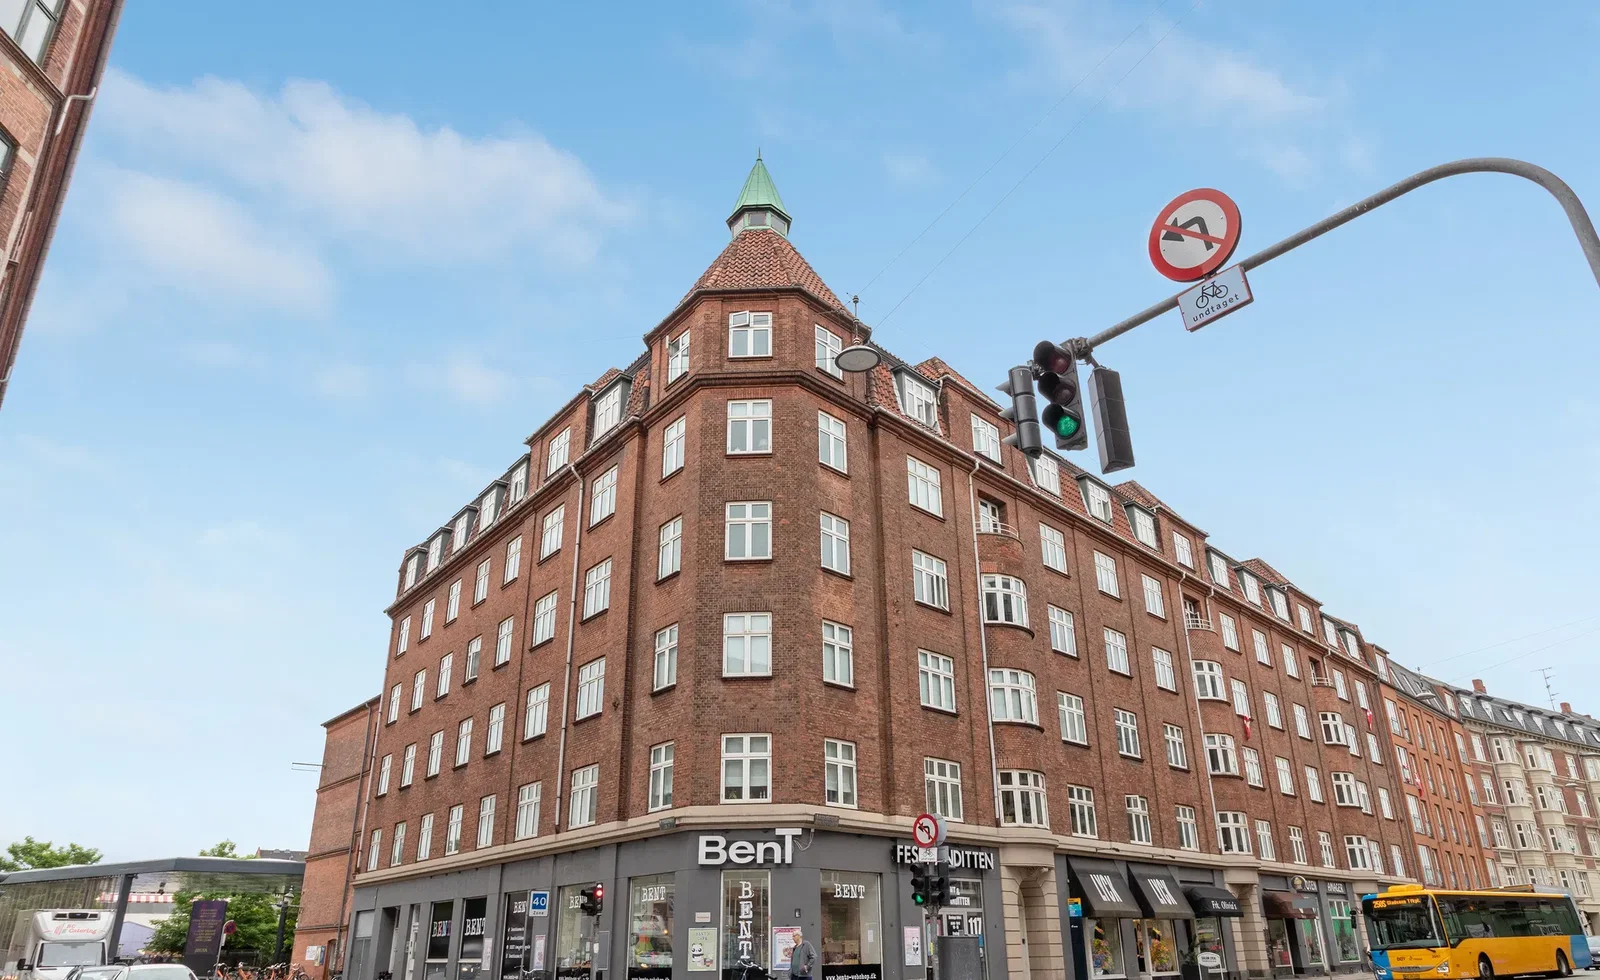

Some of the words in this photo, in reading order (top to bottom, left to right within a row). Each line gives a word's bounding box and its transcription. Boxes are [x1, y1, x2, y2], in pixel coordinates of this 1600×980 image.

[1192, 293, 1240, 323] undtaget
[641, 886, 667, 902] BENT
[834, 883, 866, 899] BENT
[532, 896, 547, 906] 40
[968, 917, 982, 934] 117
